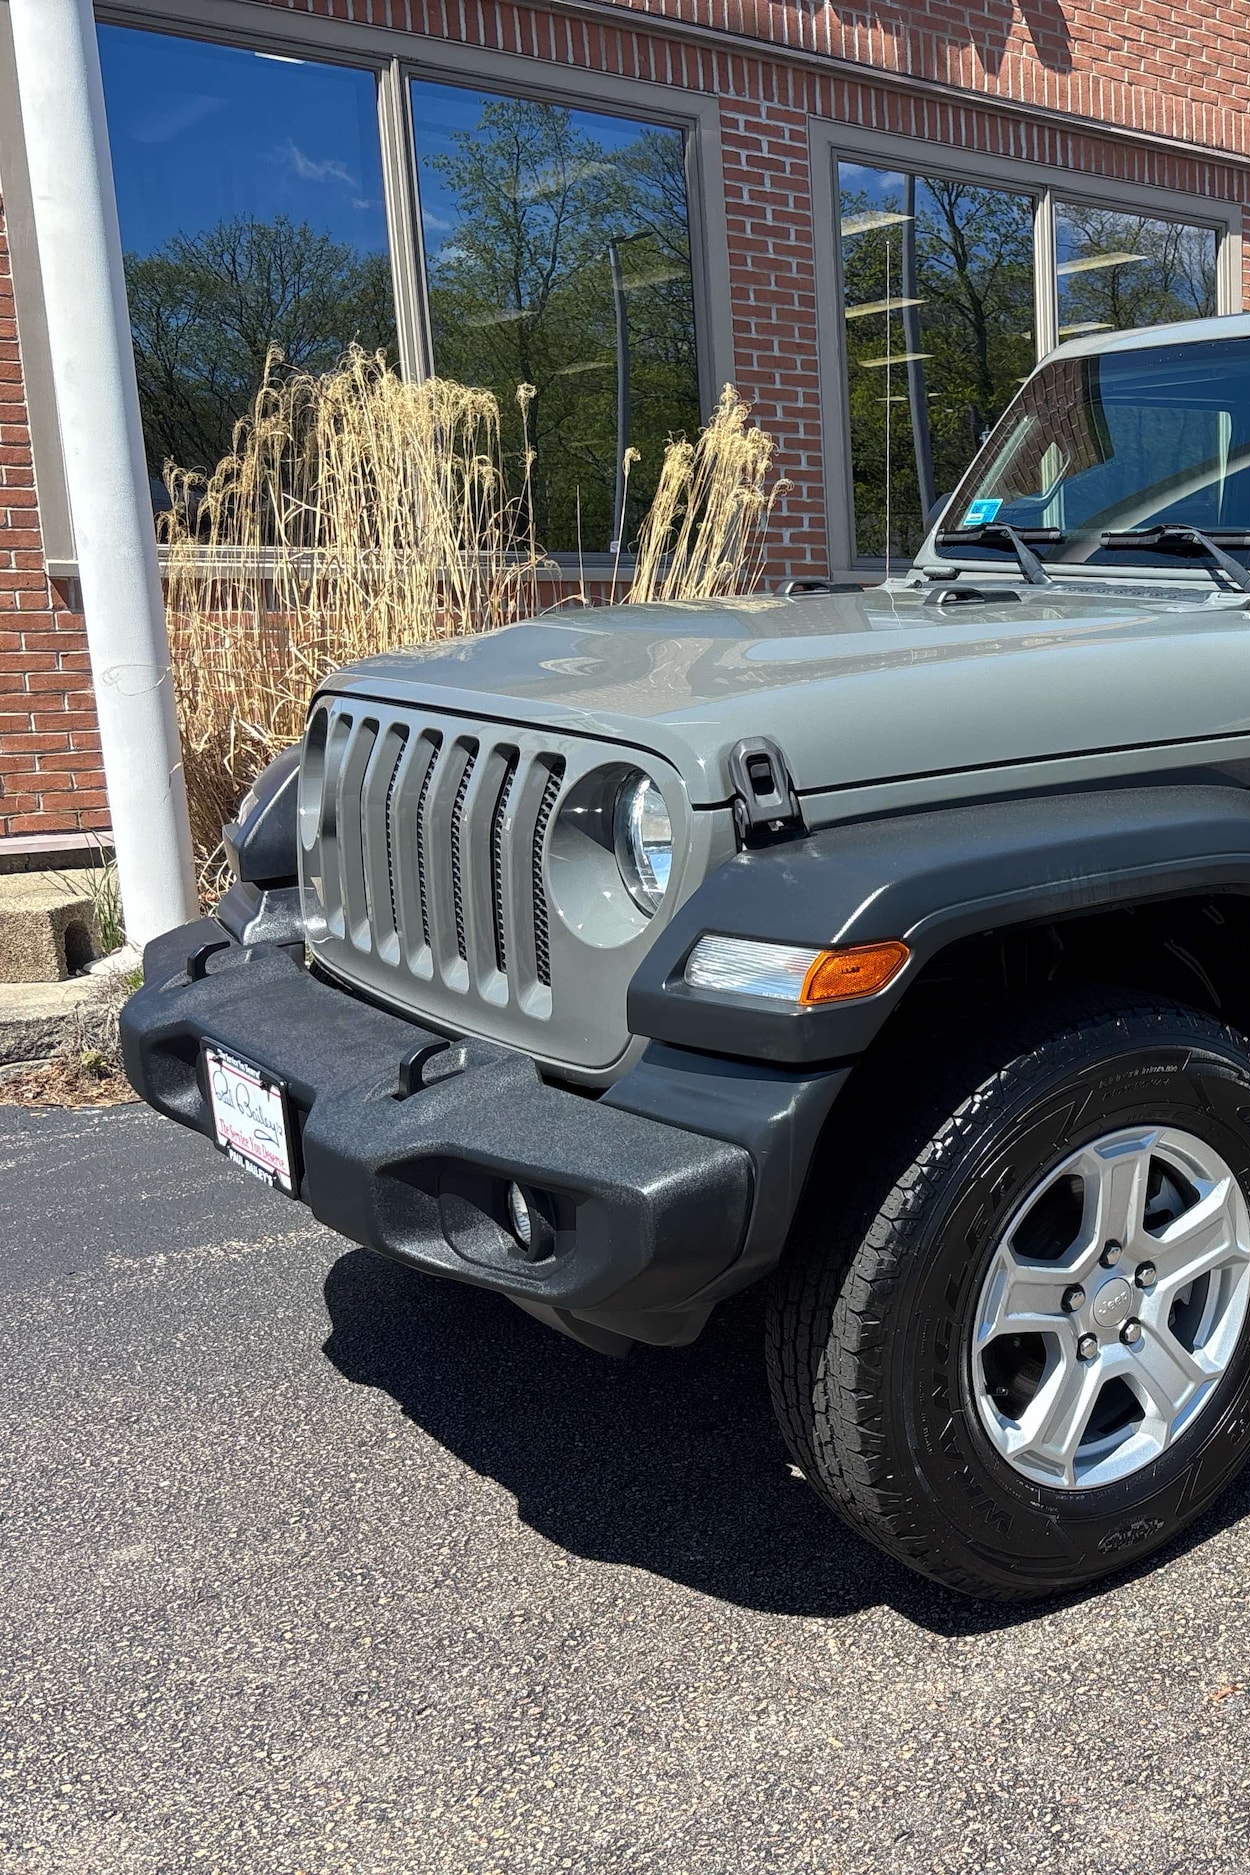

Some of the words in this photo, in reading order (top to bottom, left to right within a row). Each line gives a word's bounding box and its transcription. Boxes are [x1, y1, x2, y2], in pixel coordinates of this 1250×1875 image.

[236, 1083, 283, 1148] Bailey's
[218, 1118, 230, 1136] The
[230, 1124, 250, 1148] Service
[250, 1139, 262, 1154] You
[262, 1146, 286, 1170] Deserve
[228, 1149, 245, 1168] PAUL
[1098, 1291, 1129, 1315] Jeep
[931, 1165, 1017, 1538] WRANGLER
